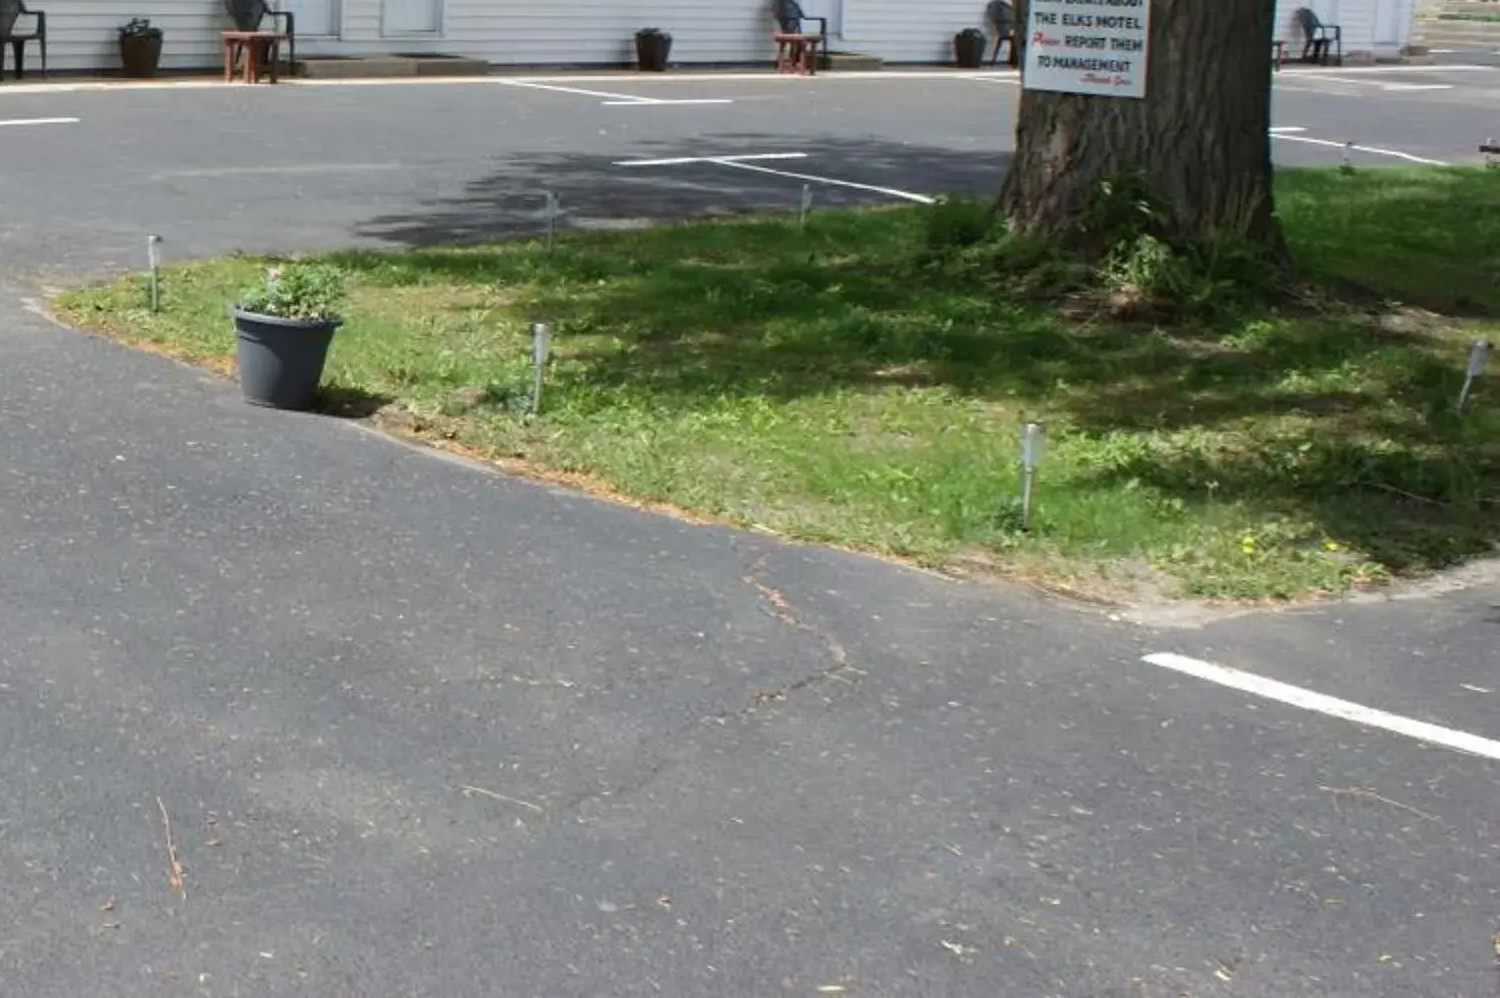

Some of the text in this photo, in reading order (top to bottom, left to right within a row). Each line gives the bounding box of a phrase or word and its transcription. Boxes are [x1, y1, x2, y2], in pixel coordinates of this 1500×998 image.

[1034, 11, 1142, 30] THE ELKS MOTEL
[1064, 35, 1107, 50] REPORT
[1111, 38, 1143, 51] THEM
[1037, 55, 1133, 72] TO MANAGEMENT
